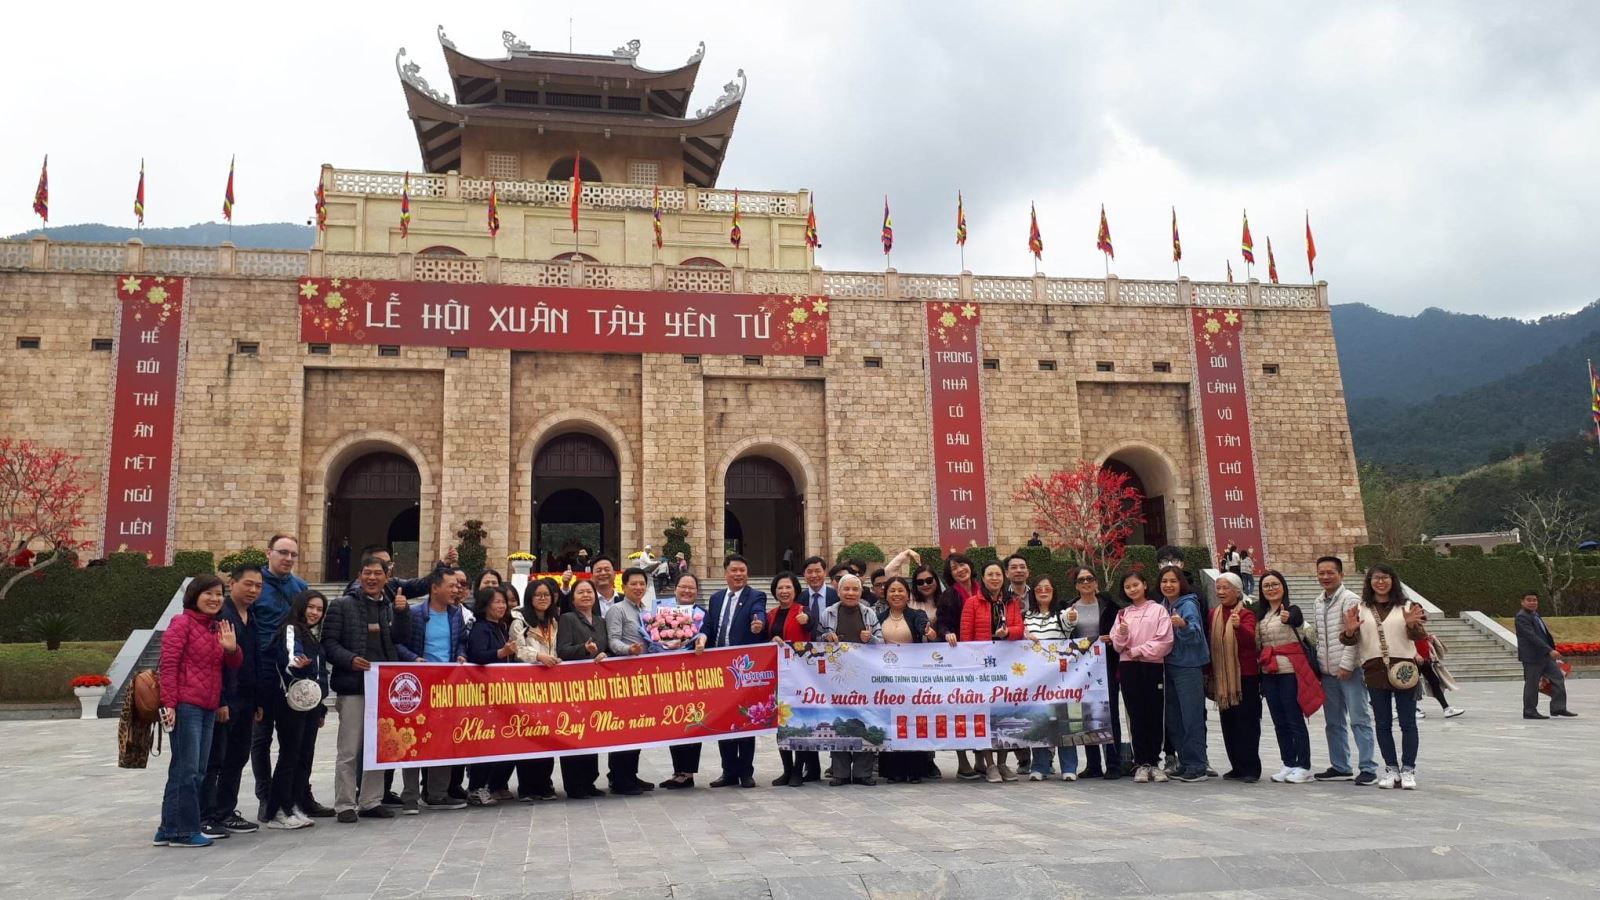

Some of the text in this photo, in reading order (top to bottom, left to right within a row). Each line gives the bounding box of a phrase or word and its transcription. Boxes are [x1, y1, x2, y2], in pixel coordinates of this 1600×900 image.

[365, 291, 771, 339] LỄ HỘI XUÂN TÂY YÊN TỬ
[935, 351, 973, 363] TRONG
[1209, 354, 1227, 368] ĐỐI
[136, 357, 160, 374] ĐÓI
[942, 376, 968, 390] NHÀ
[1207, 379, 1237, 394] CẢNH
[133, 390, 159, 406] THÌ
[949, 403, 964, 418] CÓ
[1217, 406, 1232, 420] VÔ
[133, 422, 154, 438] ĂN
[946, 431, 969, 445] BÁU
[1216, 433, 1241, 447] TÂM
[124, 454, 157, 473] MỆT
[945, 459, 974, 473] THÔI
[1219, 460, 1242, 474] CHỚ
[124, 485, 153, 502] NGỦ
[950, 488, 972, 501] TÌM
[1225, 486, 1243, 501] HỎI
[950, 514, 976, 530] KIẾM
[430, 662, 724, 708] CHÀO MỪNG ĐOÀN KHÁCH DU LỊCH ĐẦU TIÊN ĐẾN TỈNH BẮC GIANG
[831, 690, 868, 705] xuân
[873, 688, 905, 705] theo
[911, 687, 943, 705] dấu
[947, 687, 985, 704] chân
[989, 685, 1029, 706] Phật
[453, 701, 706, 744] Khai Xuân Quý Mão năm 2023
